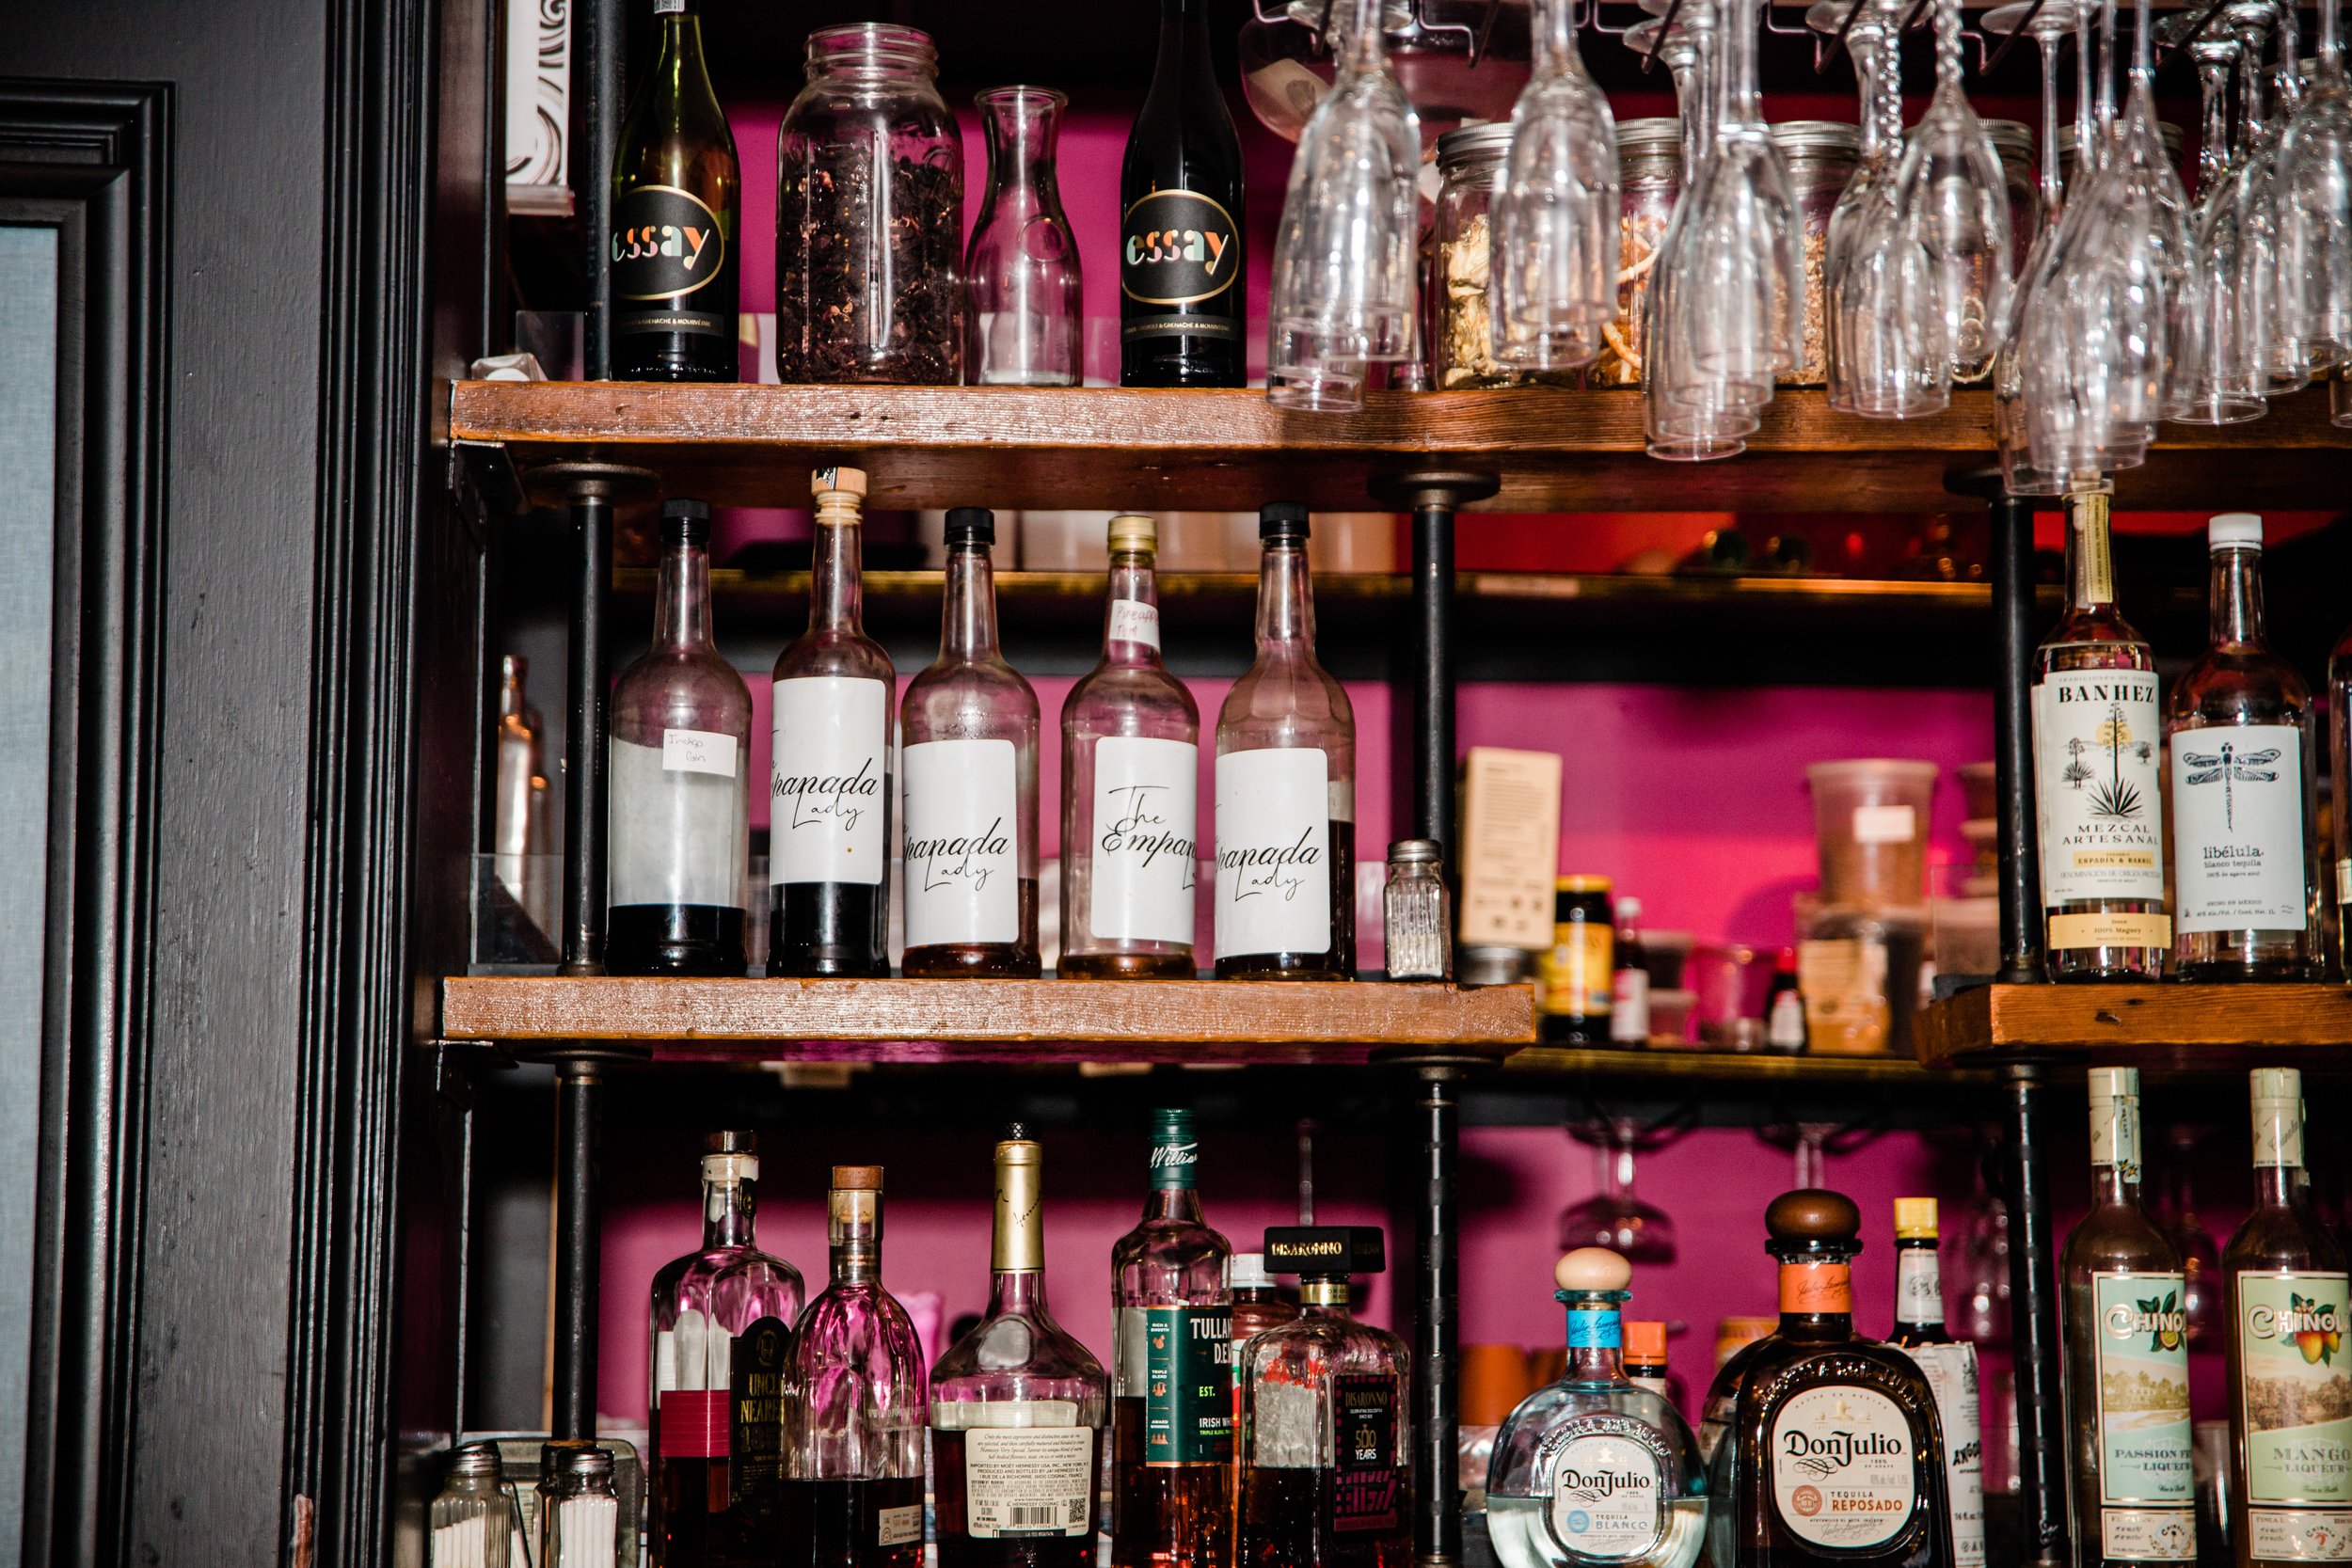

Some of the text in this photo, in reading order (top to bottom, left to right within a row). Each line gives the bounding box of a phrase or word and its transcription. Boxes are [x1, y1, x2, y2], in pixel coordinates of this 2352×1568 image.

[1126, 229, 1229, 275] essay
[2058, 684, 2154, 704] BANHEZ
[686, 751, 706, 763] Gin
[792, 790, 865, 832] Lady
[1108, 785, 1169, 836] The
[2078, 824, 2150, 833] MEZCAL
[2062, 835, 2159, 846] ARTESANAL
[924, 847, 994, 893] Lady
[2204, 861, 2230, 869] blanco
[1235, 856, 1306, 902] Lady
[1271, 1242, 1343, 1256] DISARONNO
[749, 1373, 781, 1397] UNCL
[1199, 1386, 1216, 1397] EST.
[1345, 1391, 1388, 1407] DISARONNO
[740, 1400, 781, 1424] NEARE
[1199, 1418, 1221, 1428] IRISH
[1356, 1430, 1376, 1449] 500
[1355, 1449, 1377, 1460] YEARS
[2115, 1449, 2177, 1459] PASSION
[2273, 1448, 2351, 1461] MANGO
[2285, 1464, 2345, 1473] LIQUEUR
[1832, 1499, 1903, 1511] REPOSADO
[1596, 1521, 1647, 1529] BLANCO
